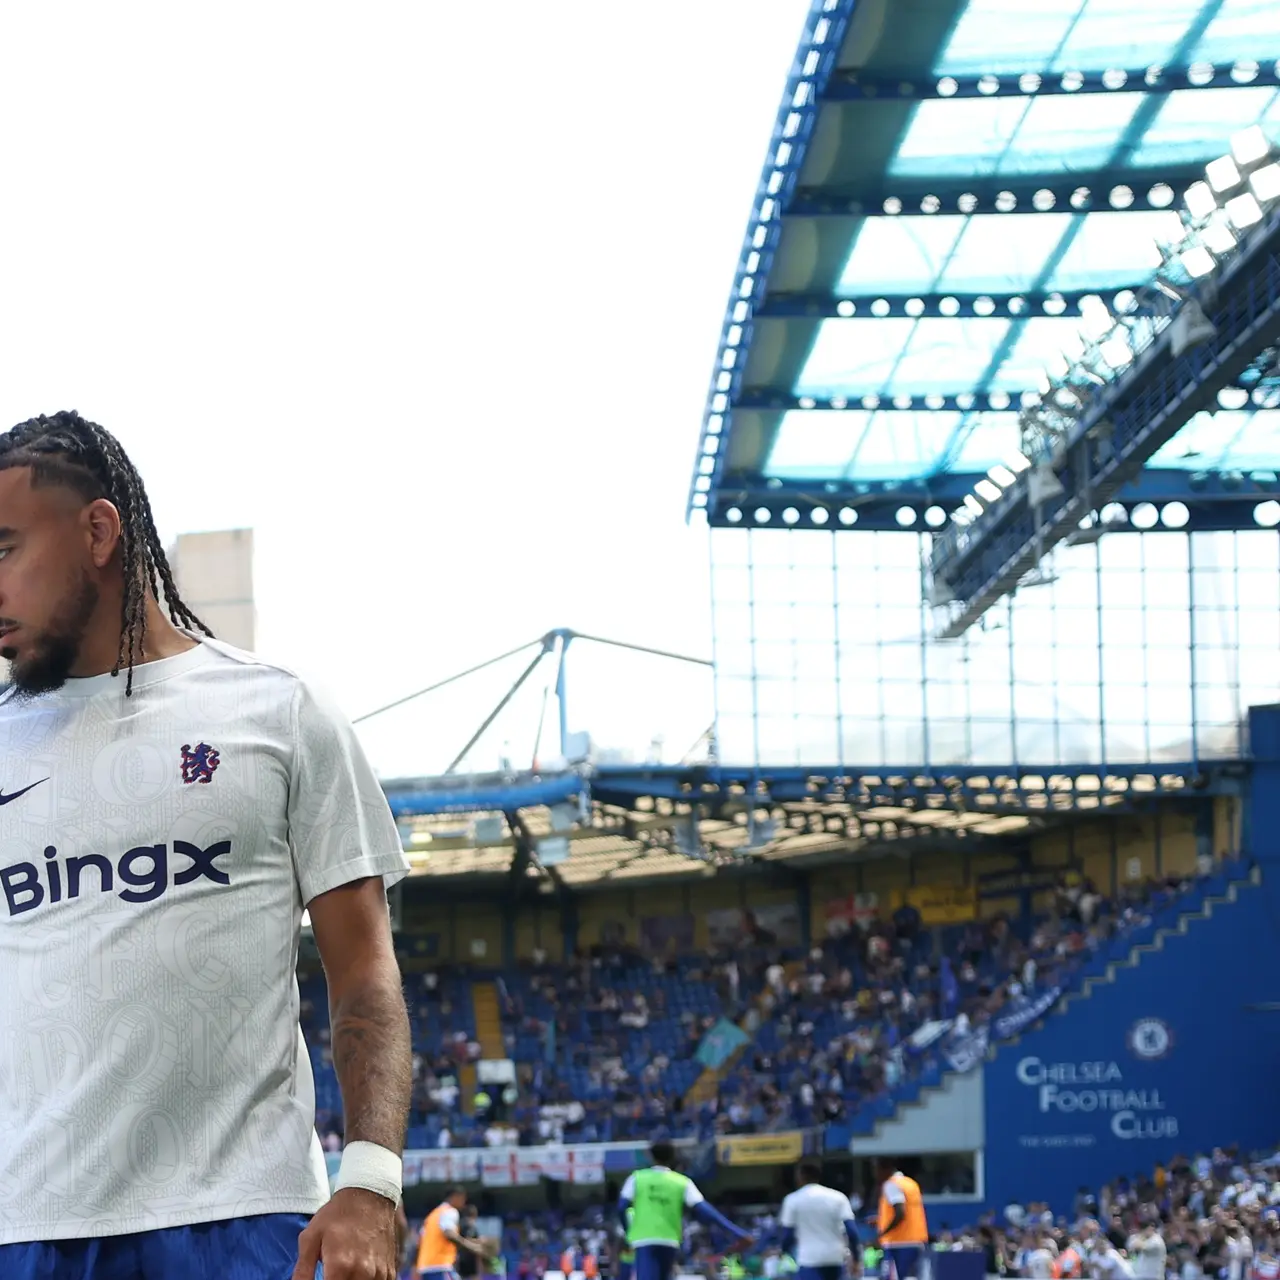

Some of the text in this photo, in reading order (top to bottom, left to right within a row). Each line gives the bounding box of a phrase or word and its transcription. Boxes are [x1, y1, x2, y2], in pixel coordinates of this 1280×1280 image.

[1016, 1055, 1123, 1085] CHELSEA
[1038, 1085, 1165, 1112] FOOTBALL
[1111, 1110, 1179, 1139] CLUB
